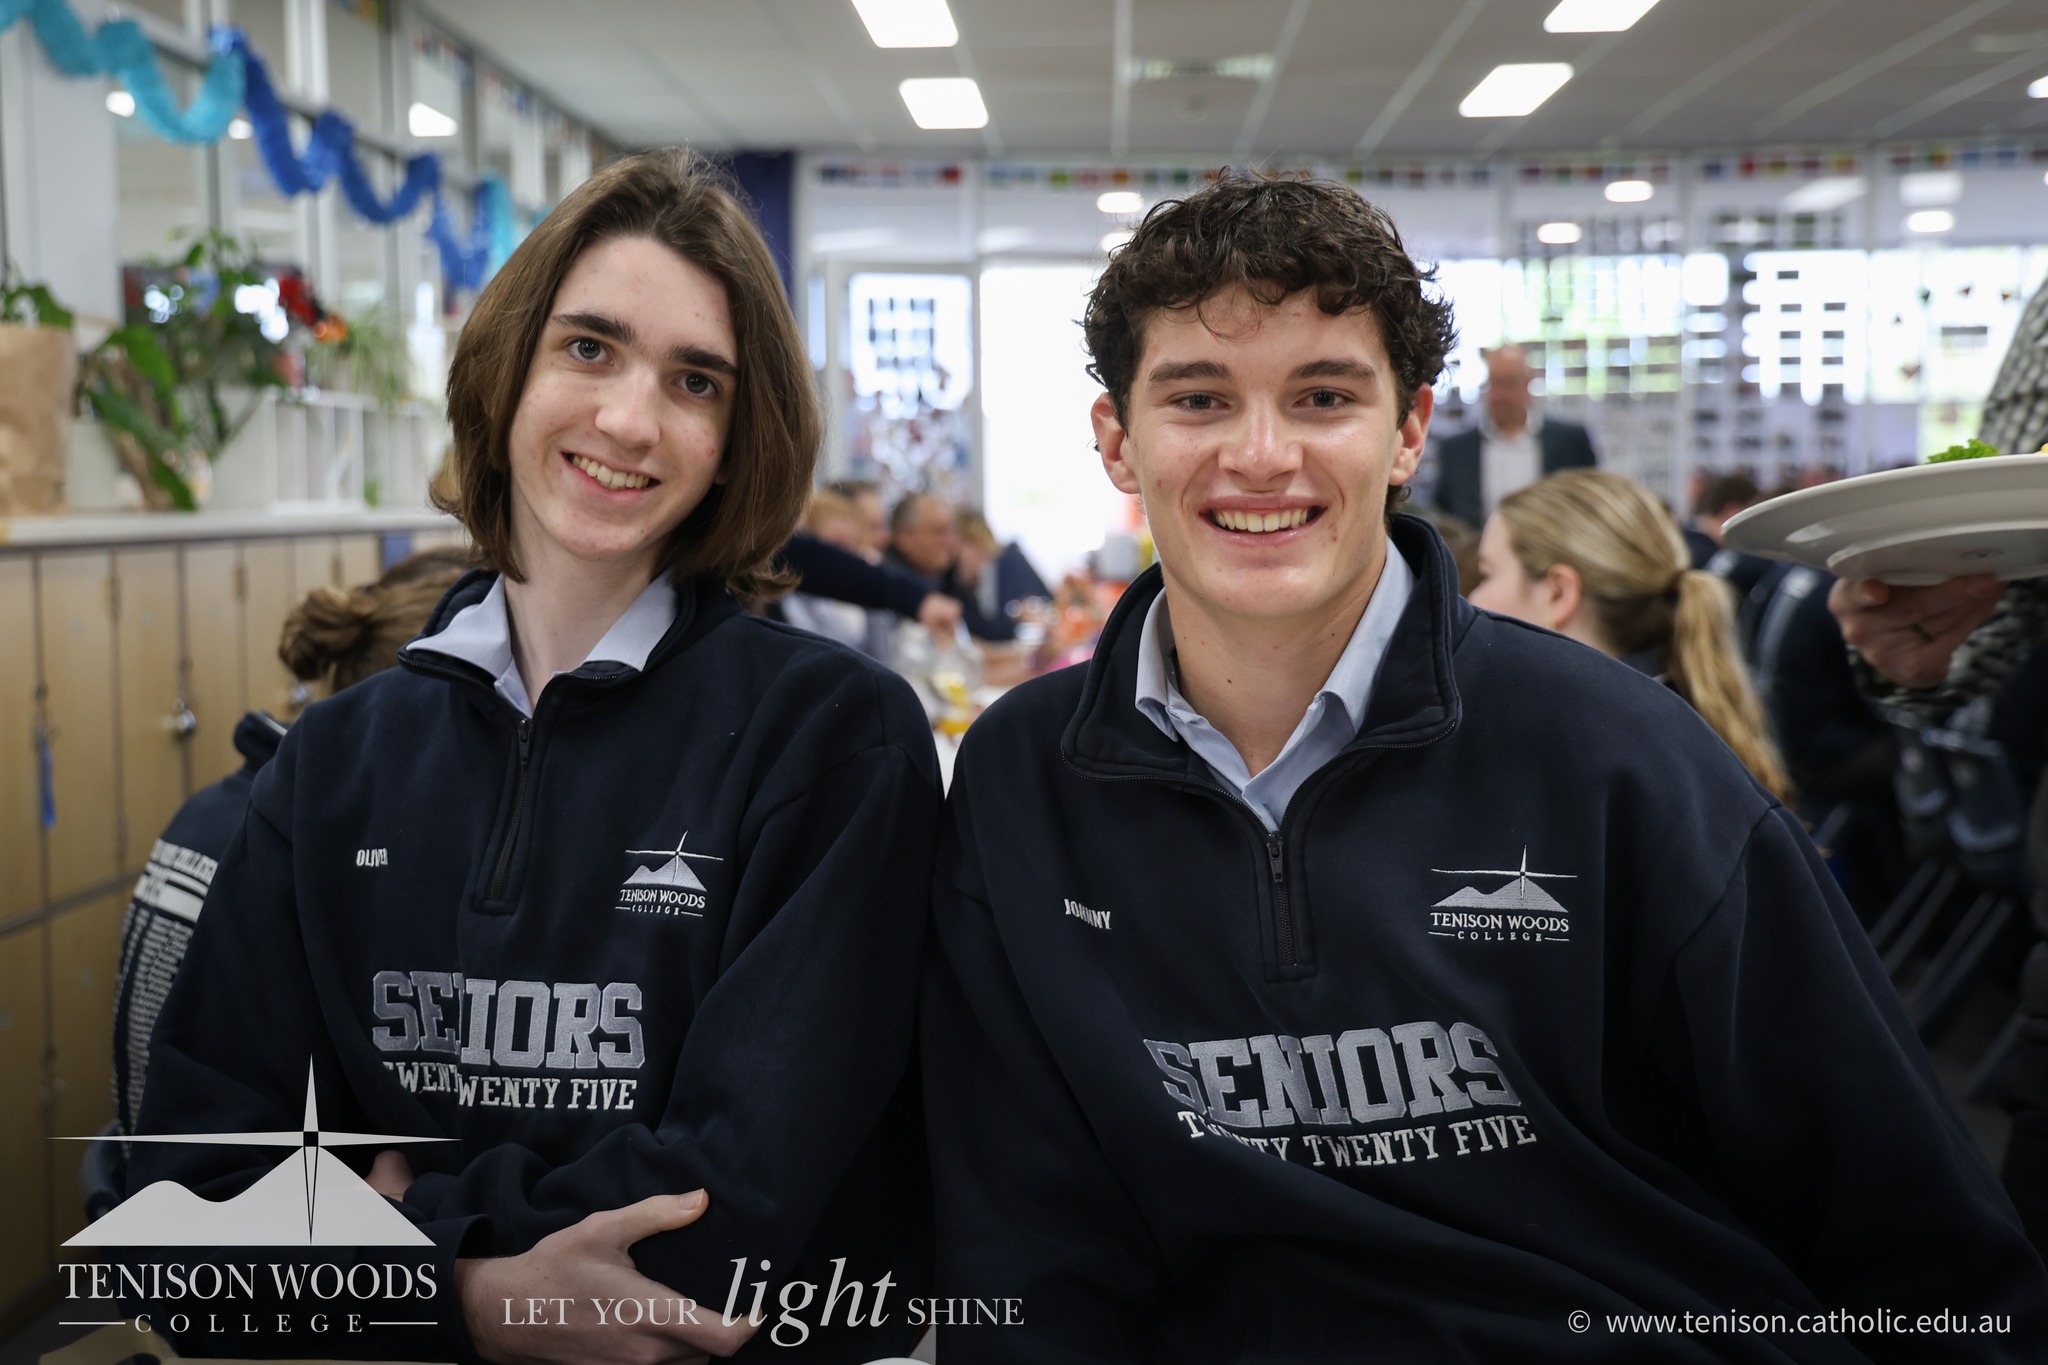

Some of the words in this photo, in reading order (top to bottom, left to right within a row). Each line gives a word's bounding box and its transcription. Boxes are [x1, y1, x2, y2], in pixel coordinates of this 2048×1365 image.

[620, 889, 657, 902] TENISON
[660, 890, 706, 908] WOODS
[632, 905, 679, 915] COLLEGE
[1430, 912, 1502, 929] TENISON
[1507, 915, 1569, 932] WOODS
[1457, 931, 1542, 942] COLLEGE
[372, 970, 645, 1069] SEIORS
[1143, 1021, 1521, 1128] SENIORS
[458, 1073, 561, 1110] WENTY
[567, 1078, 637, 1110] FIVE
[1303, 1126, 1439, 1167] TWENTY
[1449, 1115, 1537, 1156] FIVE
